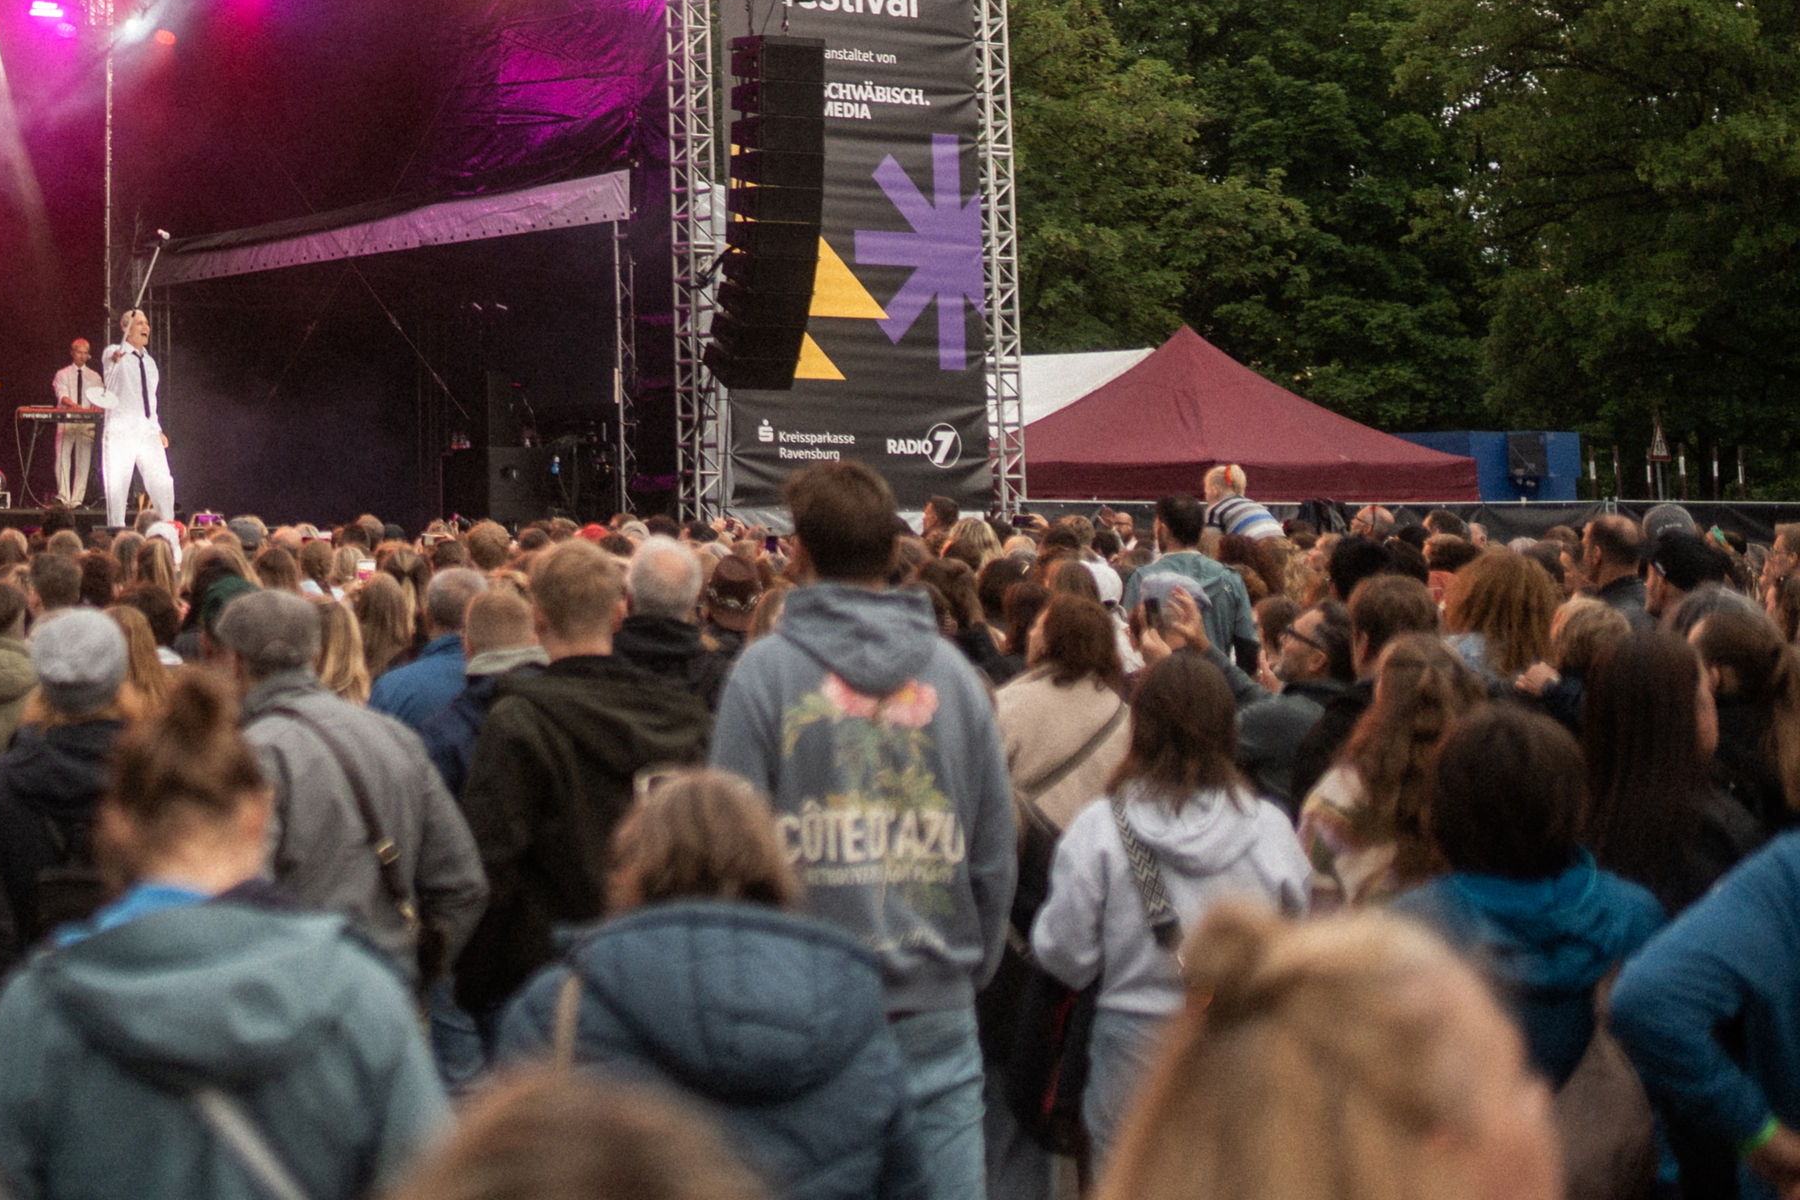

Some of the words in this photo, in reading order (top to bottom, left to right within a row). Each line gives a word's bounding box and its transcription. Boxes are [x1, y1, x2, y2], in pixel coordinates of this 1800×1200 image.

[824, 48, 874, 63] anstaltet
[876, 53, 897, 64] von
[778, 431, 856, 445] Kreissparkasse
[779, 447, 841, 462] Ravensburg
[886, 438, 933, 455] RADIO
[933, 430, 957, 464] 7
[866, 805, 967, 864] D'AZU
